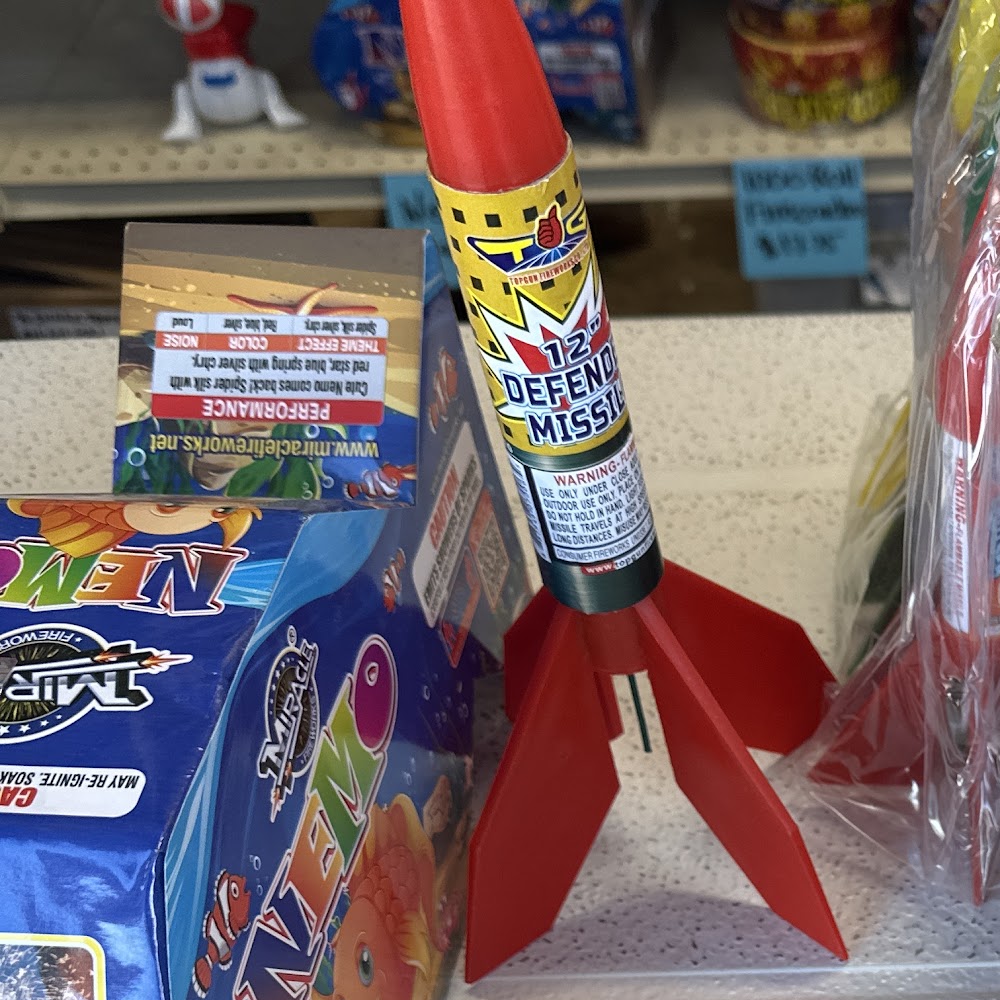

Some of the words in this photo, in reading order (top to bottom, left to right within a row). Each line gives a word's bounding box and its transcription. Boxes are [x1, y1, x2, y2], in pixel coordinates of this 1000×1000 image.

[510, 271, 539, 286] TOPGUN
[172, 317, 194, 329] Loud
[163, 333, 199, 348] NOISE
[229, 336, 268, 350] COLOR
[298, 337, 339, 352] EFFECT
[341, 339, 380, 353] THEME
[217, 356, 247, 370] silver
[249, 357, 270, 371] with
[271, 355, 303, 370] spring
[305, 359, 327, 372] blue
[353, 359, 369, 373] red
[169, 375, 193, 391] with
[193, 376, 212, 392] silk
[213, 375, 247, 393] Spider
[278, 379, 312, 392] comes
[313, 380, 343, 395] Nemo
[345, 380, 369, 397] Cute
[201, 398, 331, 421] PERFORMANCE
[528, 387, 626, 445] MISSIL
[149, 434, 380, 460] www.miraclefireworks.net
[540, 486, 554, 498] USE
[559, 489, 578, 500] ONLY
[583, 482, 608, 498] UNDER
[544, 501, 579, 512] OUTDOOR
[581, 498, 597, 510] USE
[559, 511, 574, 523] NOT
[575, 510, 596, 523] HOLD
[597, 508, 604, 519] IN
[581, 517, 613, 533] TRAVELS
[615, 512, 624, 524] AT
[259, 641, 318, 782] MIRACLE
[39, 772, 109, 788] RE-IGNITE.
[107, 775, 140, 788] MAY
